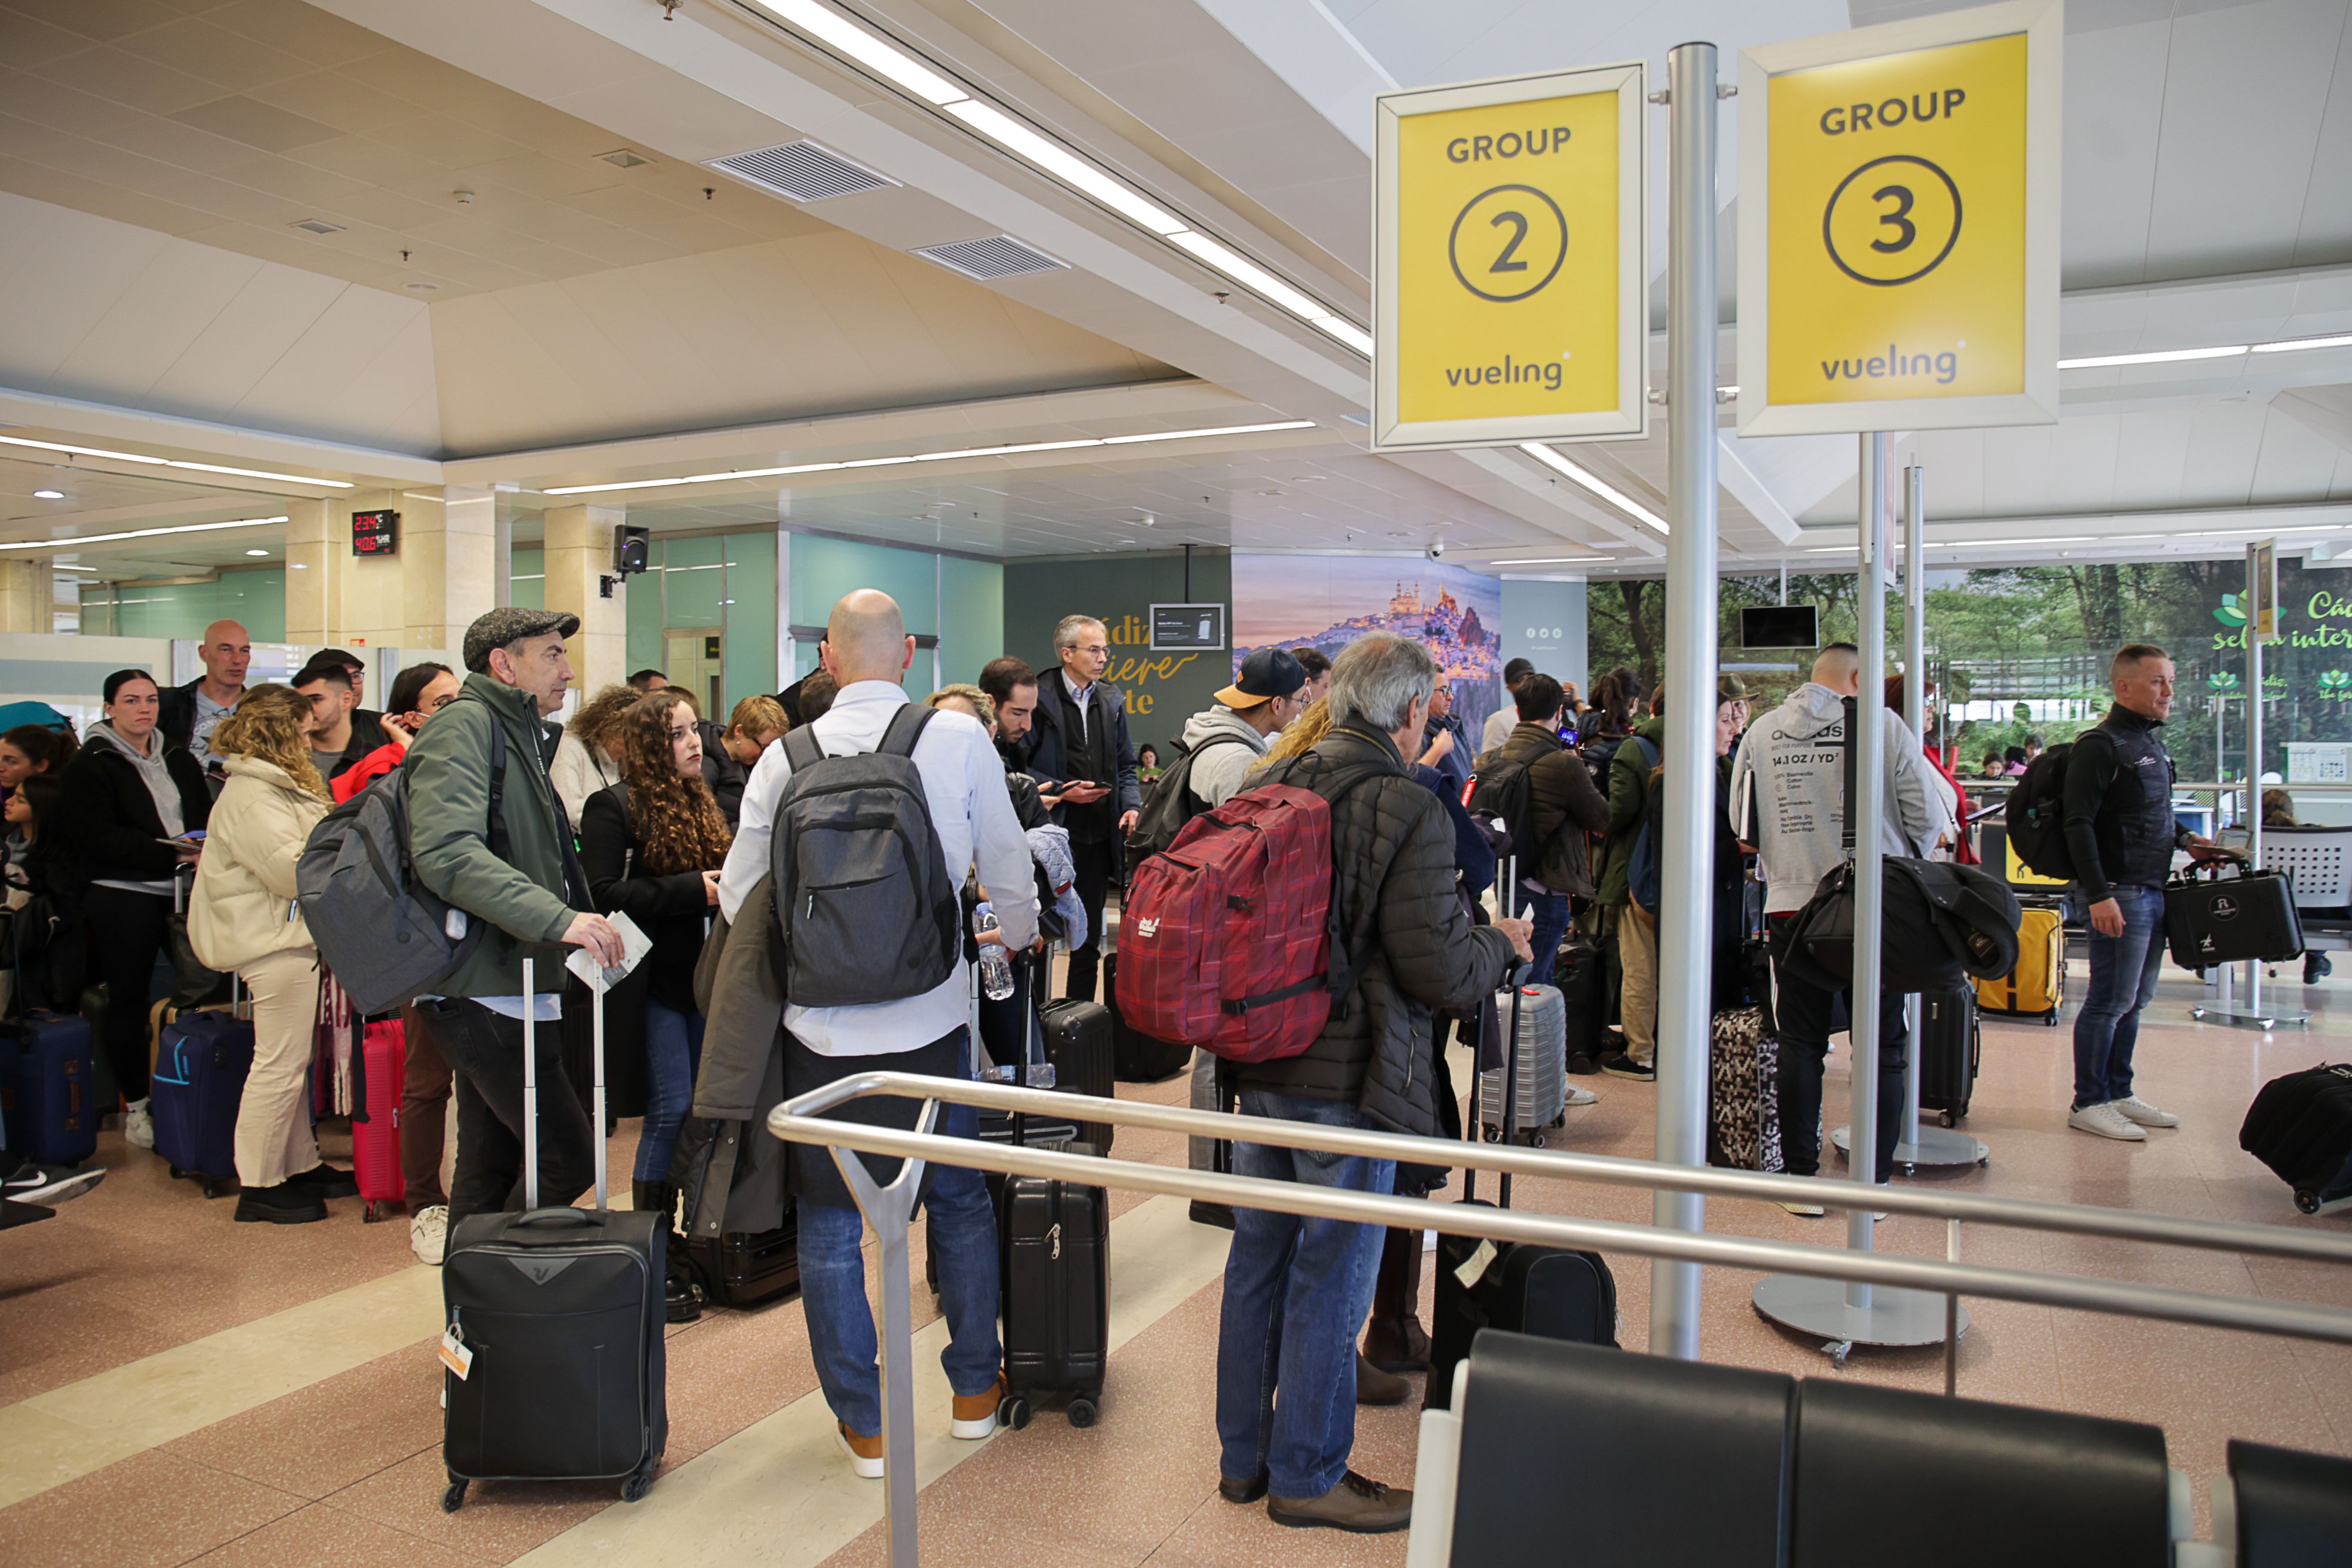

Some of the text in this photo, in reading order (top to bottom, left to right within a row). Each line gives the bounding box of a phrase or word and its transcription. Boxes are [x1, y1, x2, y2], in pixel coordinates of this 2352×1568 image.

[1820, 89, 1966, 136] GROUP
[1446, 127, 1571, 163] GROUP
[1870, 185, 1916, 253] 3
[1489, 211, 1528, 273] 2
[1446, 355, 1562, 390] vueling
[1821, 343, 1957, 385] vueling
[1772, 755, 1789, 767] 14.1
[1791, 754, 1808, 764] OZ
[1810, 754, 1815, 763] /
